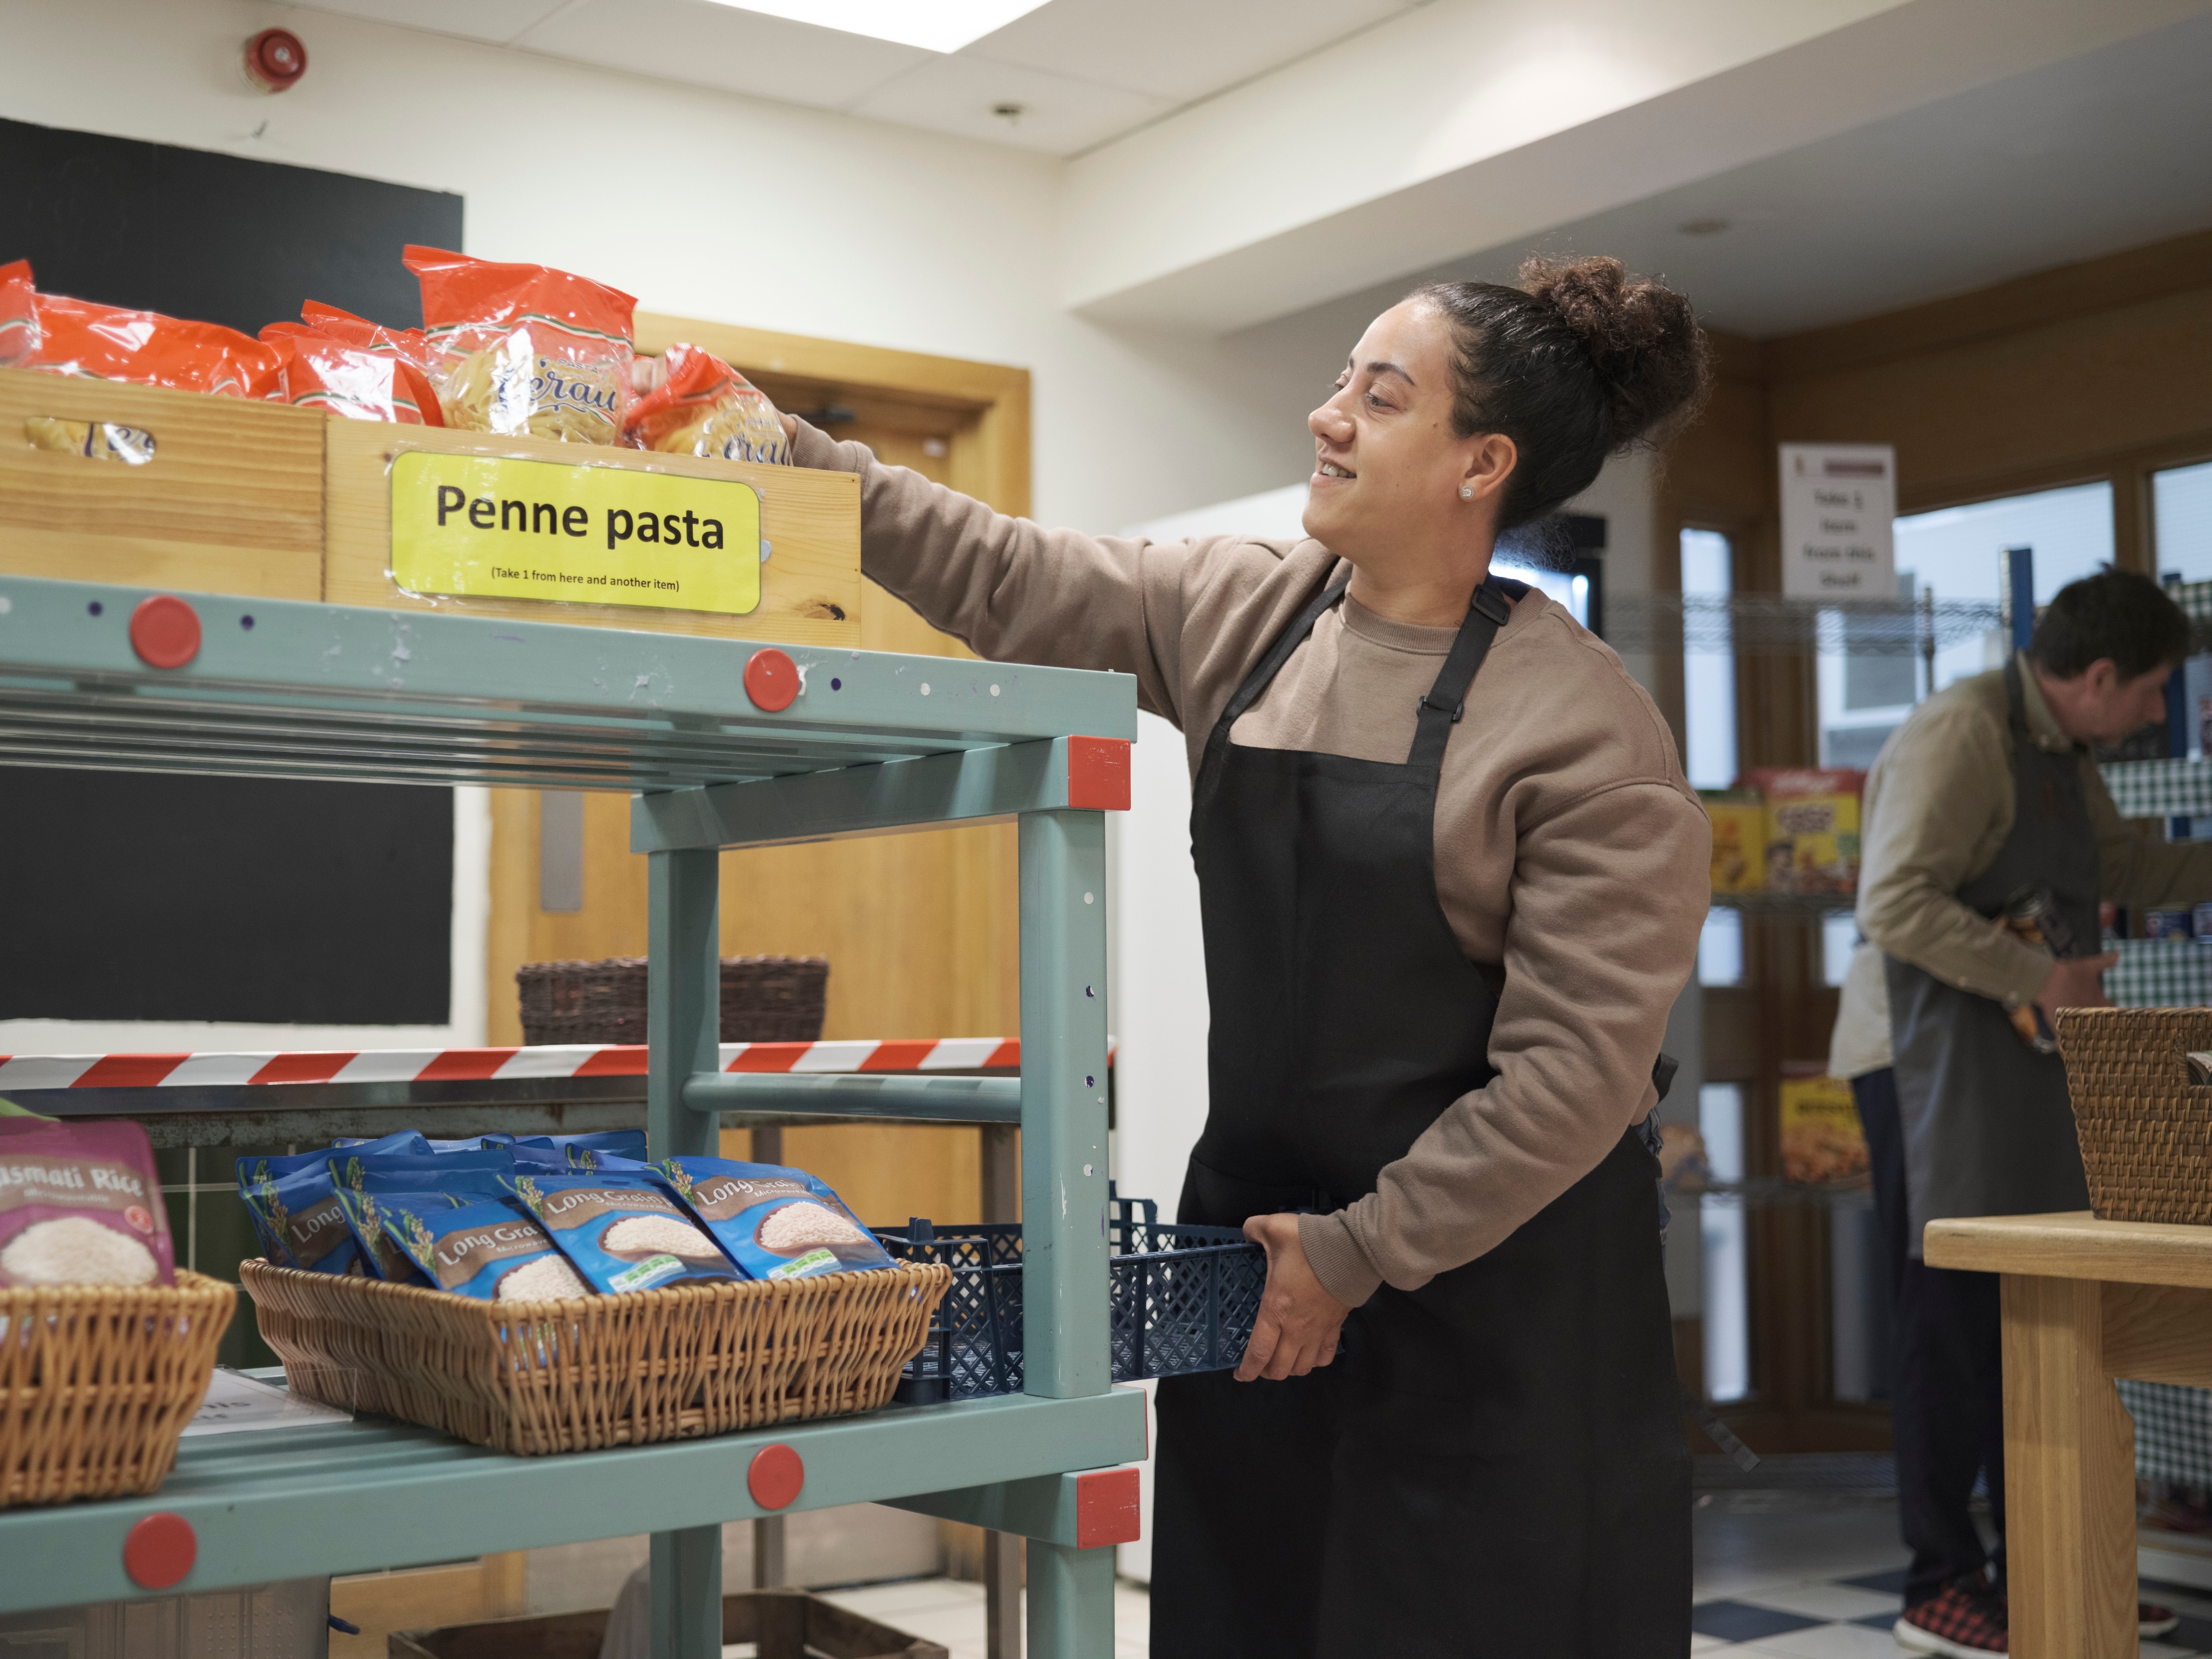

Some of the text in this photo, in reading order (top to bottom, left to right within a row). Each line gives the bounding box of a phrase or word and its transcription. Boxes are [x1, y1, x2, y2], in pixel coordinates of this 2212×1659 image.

[557, 358, 598, 374] PASTA
[437, 485, 724, 550] Penne pasta
[491, 567, 679, 592] (Take 1 from here and another item)
[90, 1168, 144, 1197] Rice
[696, 1179, 754, 1205] Long
[547, 1192, 605, 1214] Long
[603, 1191, 663, 1204] Grain
[291, 1206, 346, 1243] Long
[437, 1235, 497, 1266] Long
